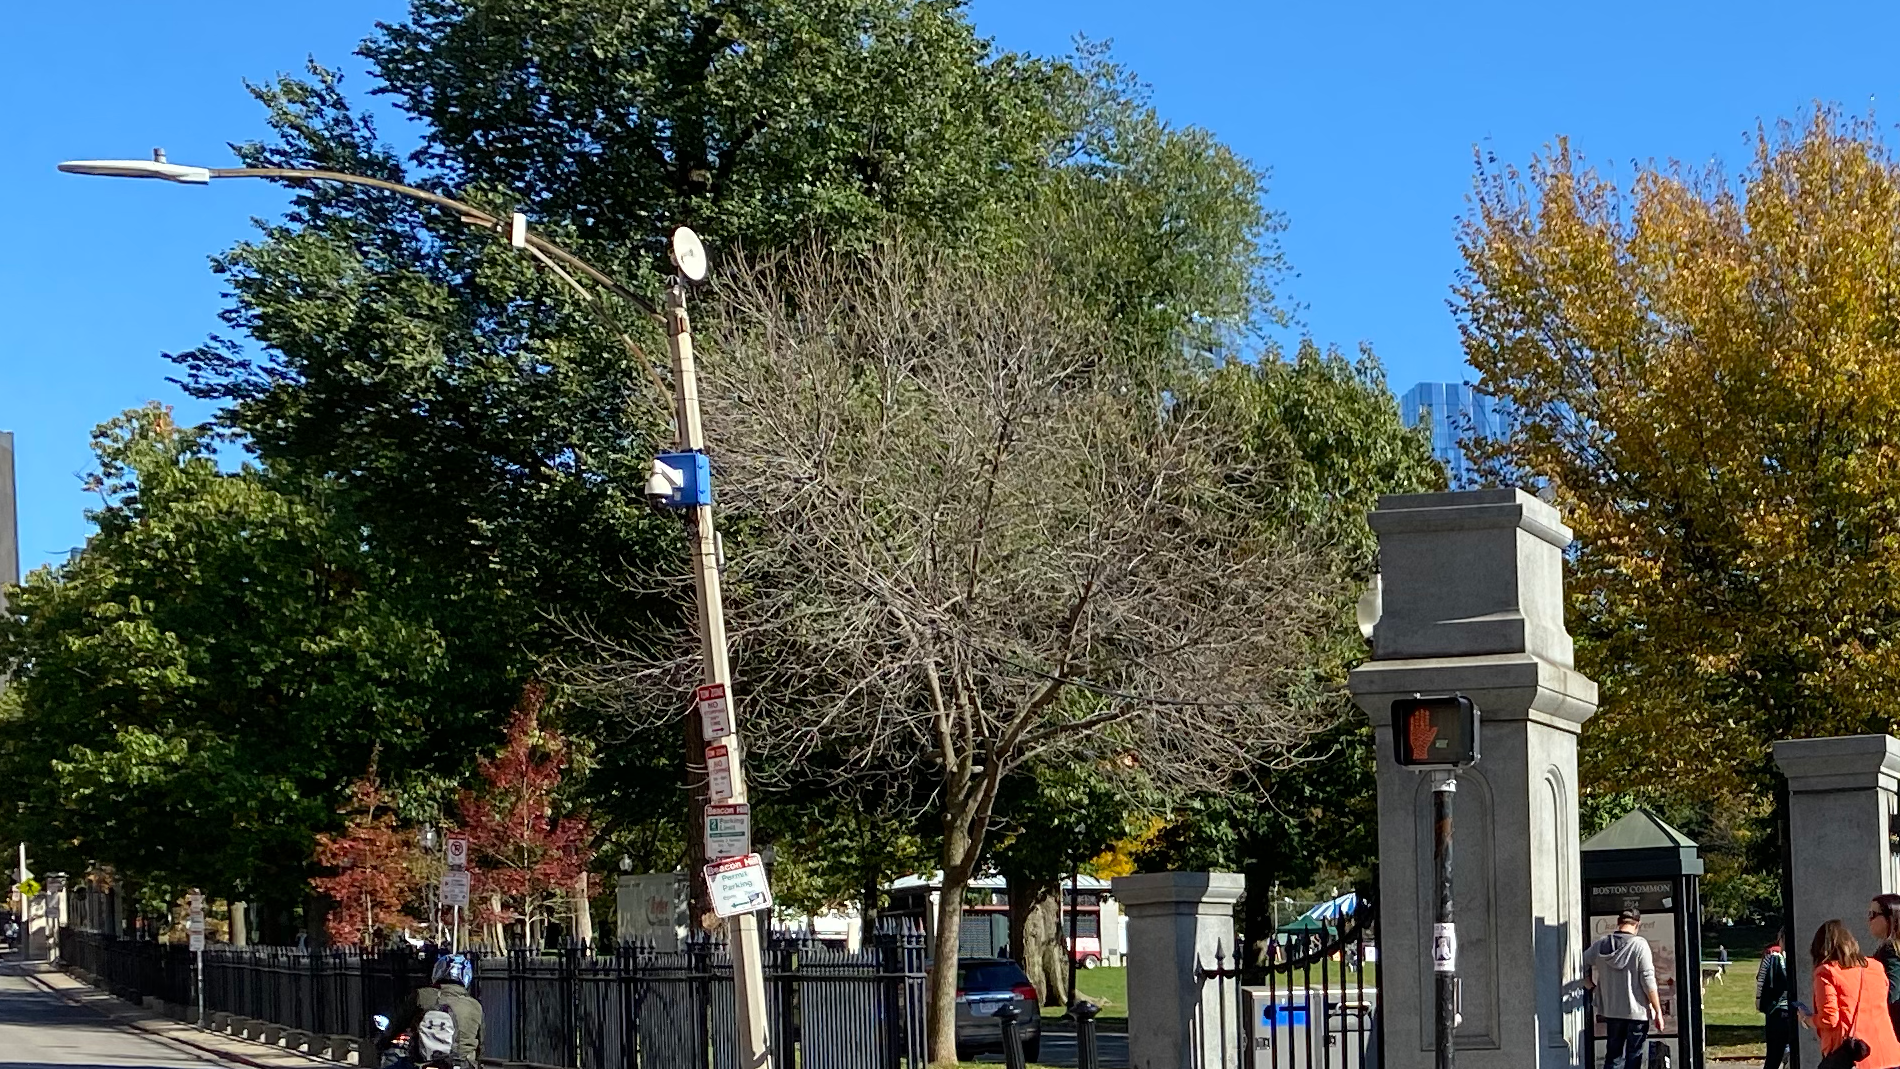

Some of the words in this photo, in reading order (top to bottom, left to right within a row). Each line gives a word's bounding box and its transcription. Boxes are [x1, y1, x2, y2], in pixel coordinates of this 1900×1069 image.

[707, 805, 735, 815] Beacon
[736, 804, 748, 814] Hill
[708, 861, 743, 876] Beacon
[744, 855, 760, 868] Hill
[721, 870, 748, 882] Permit
[722, 880, 753, 892] Parking
[1592, 885, 1628, 895] BOSTON
[1629, 883, 1671, 894] COMMON
